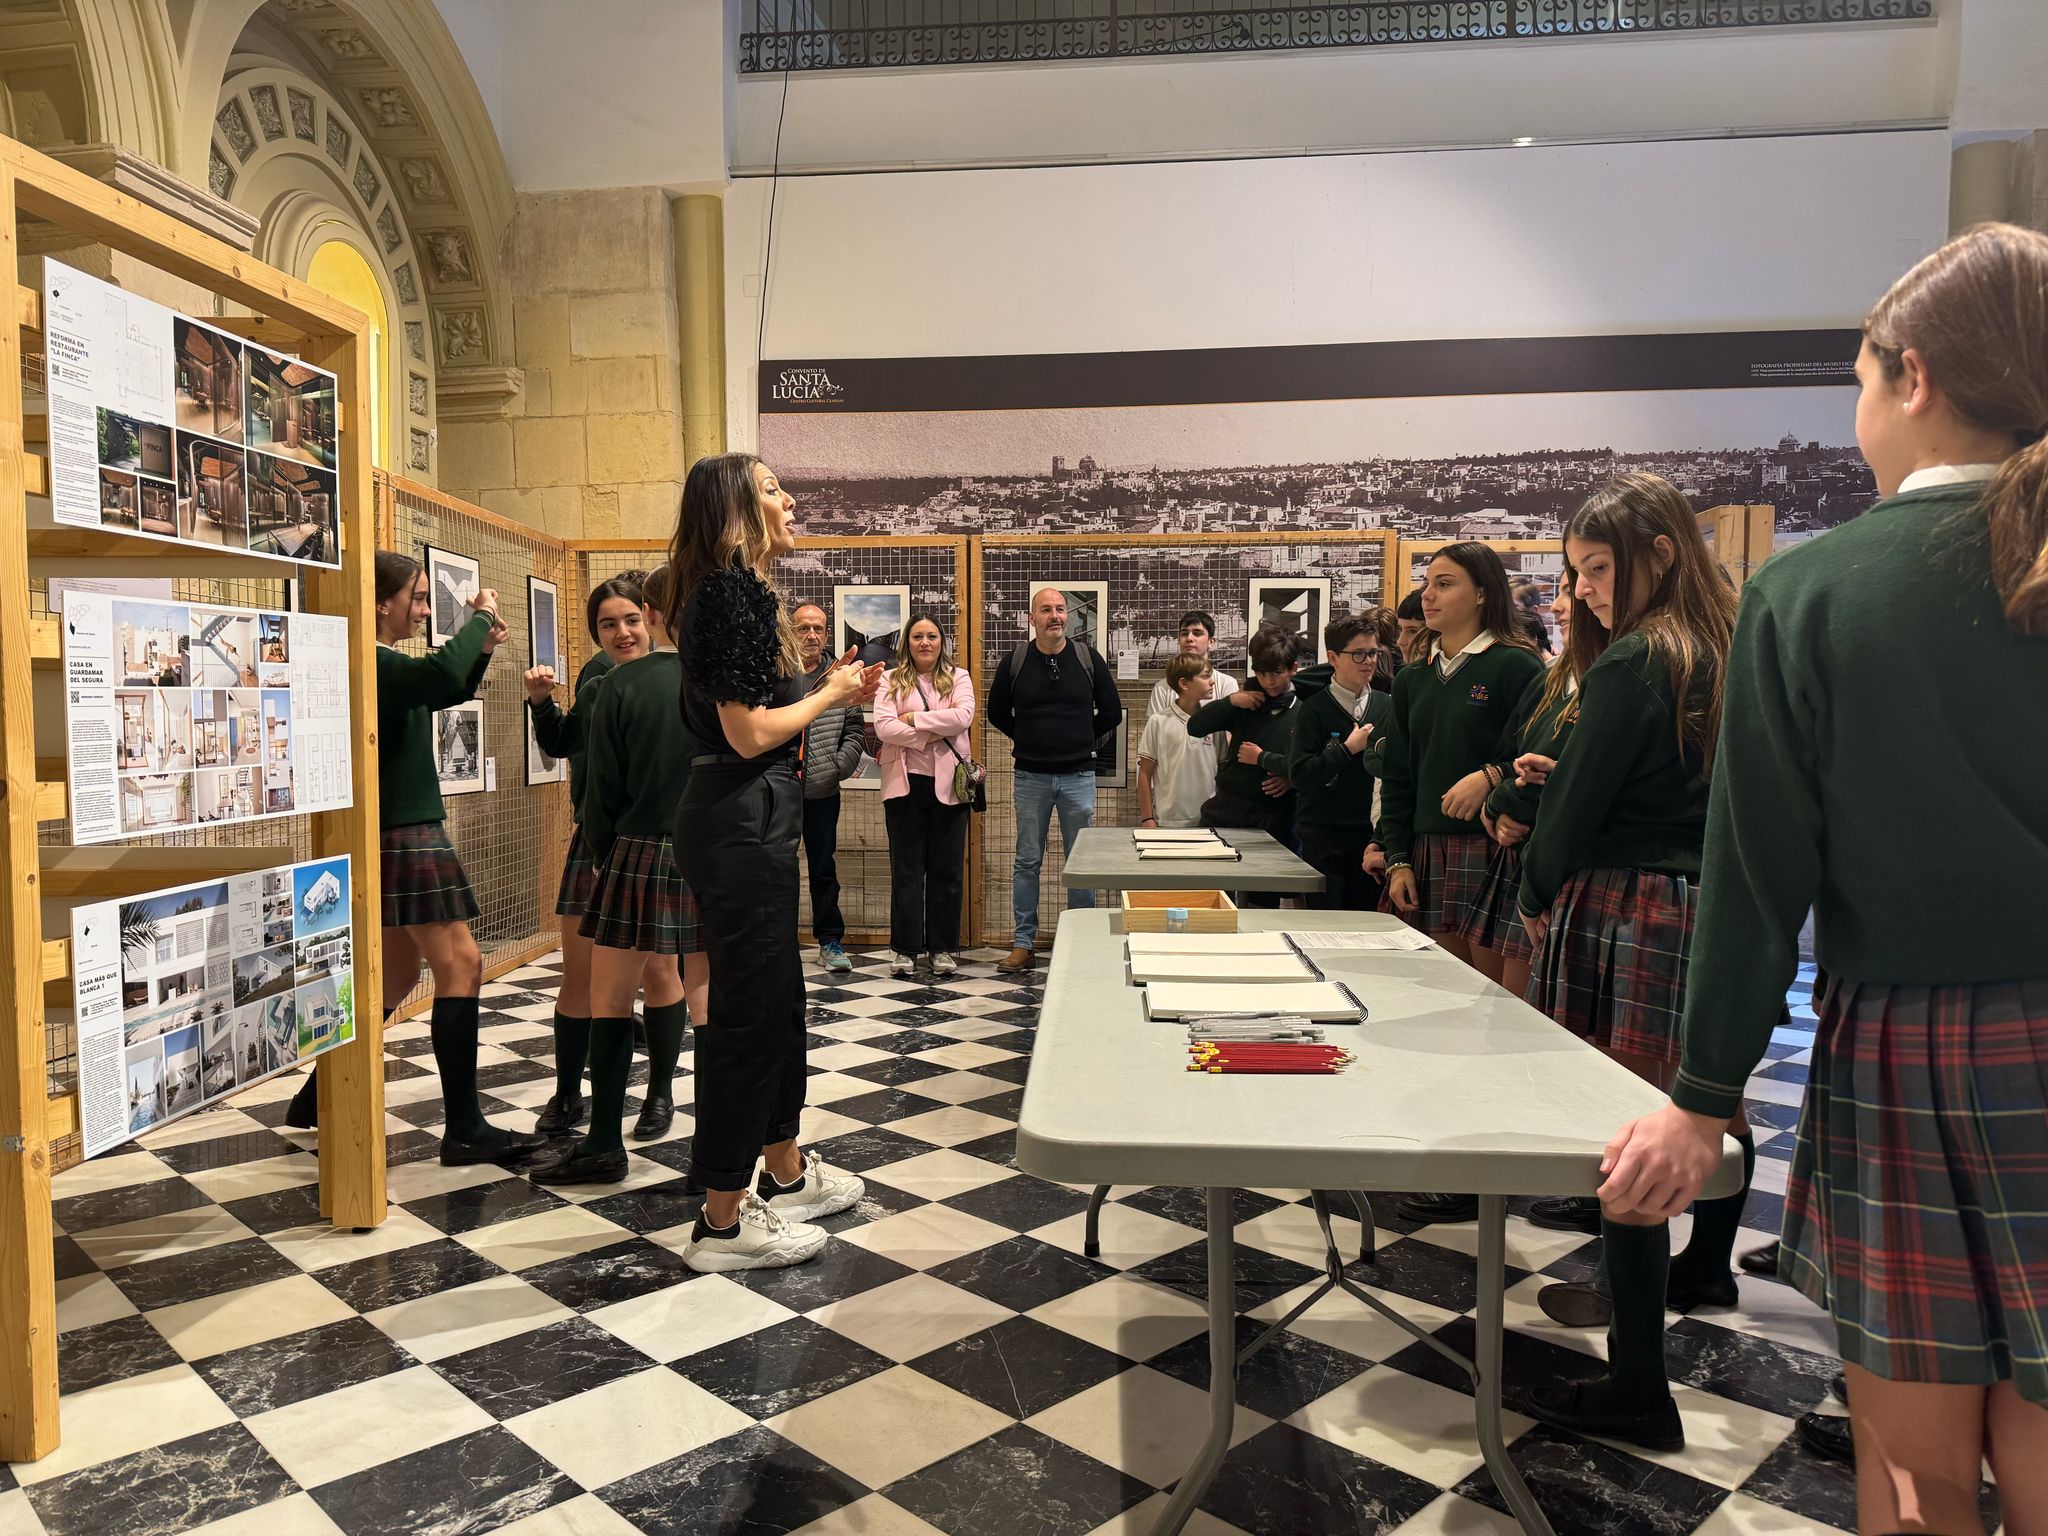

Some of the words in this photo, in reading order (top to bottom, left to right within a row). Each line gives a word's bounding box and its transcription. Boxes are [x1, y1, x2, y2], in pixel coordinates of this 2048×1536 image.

[50, 331, 77, 345] REFORMA
[50, 340, 89, 358] RESTAURANTE
[780, 371, 832, 386] SANTA
[772, 382, 820, 399] LUCÍA
[79, 980, 94, 988] CASA
[106, 971, 118, 979] QUE
[80, 984, 101, 995] BLANCA
